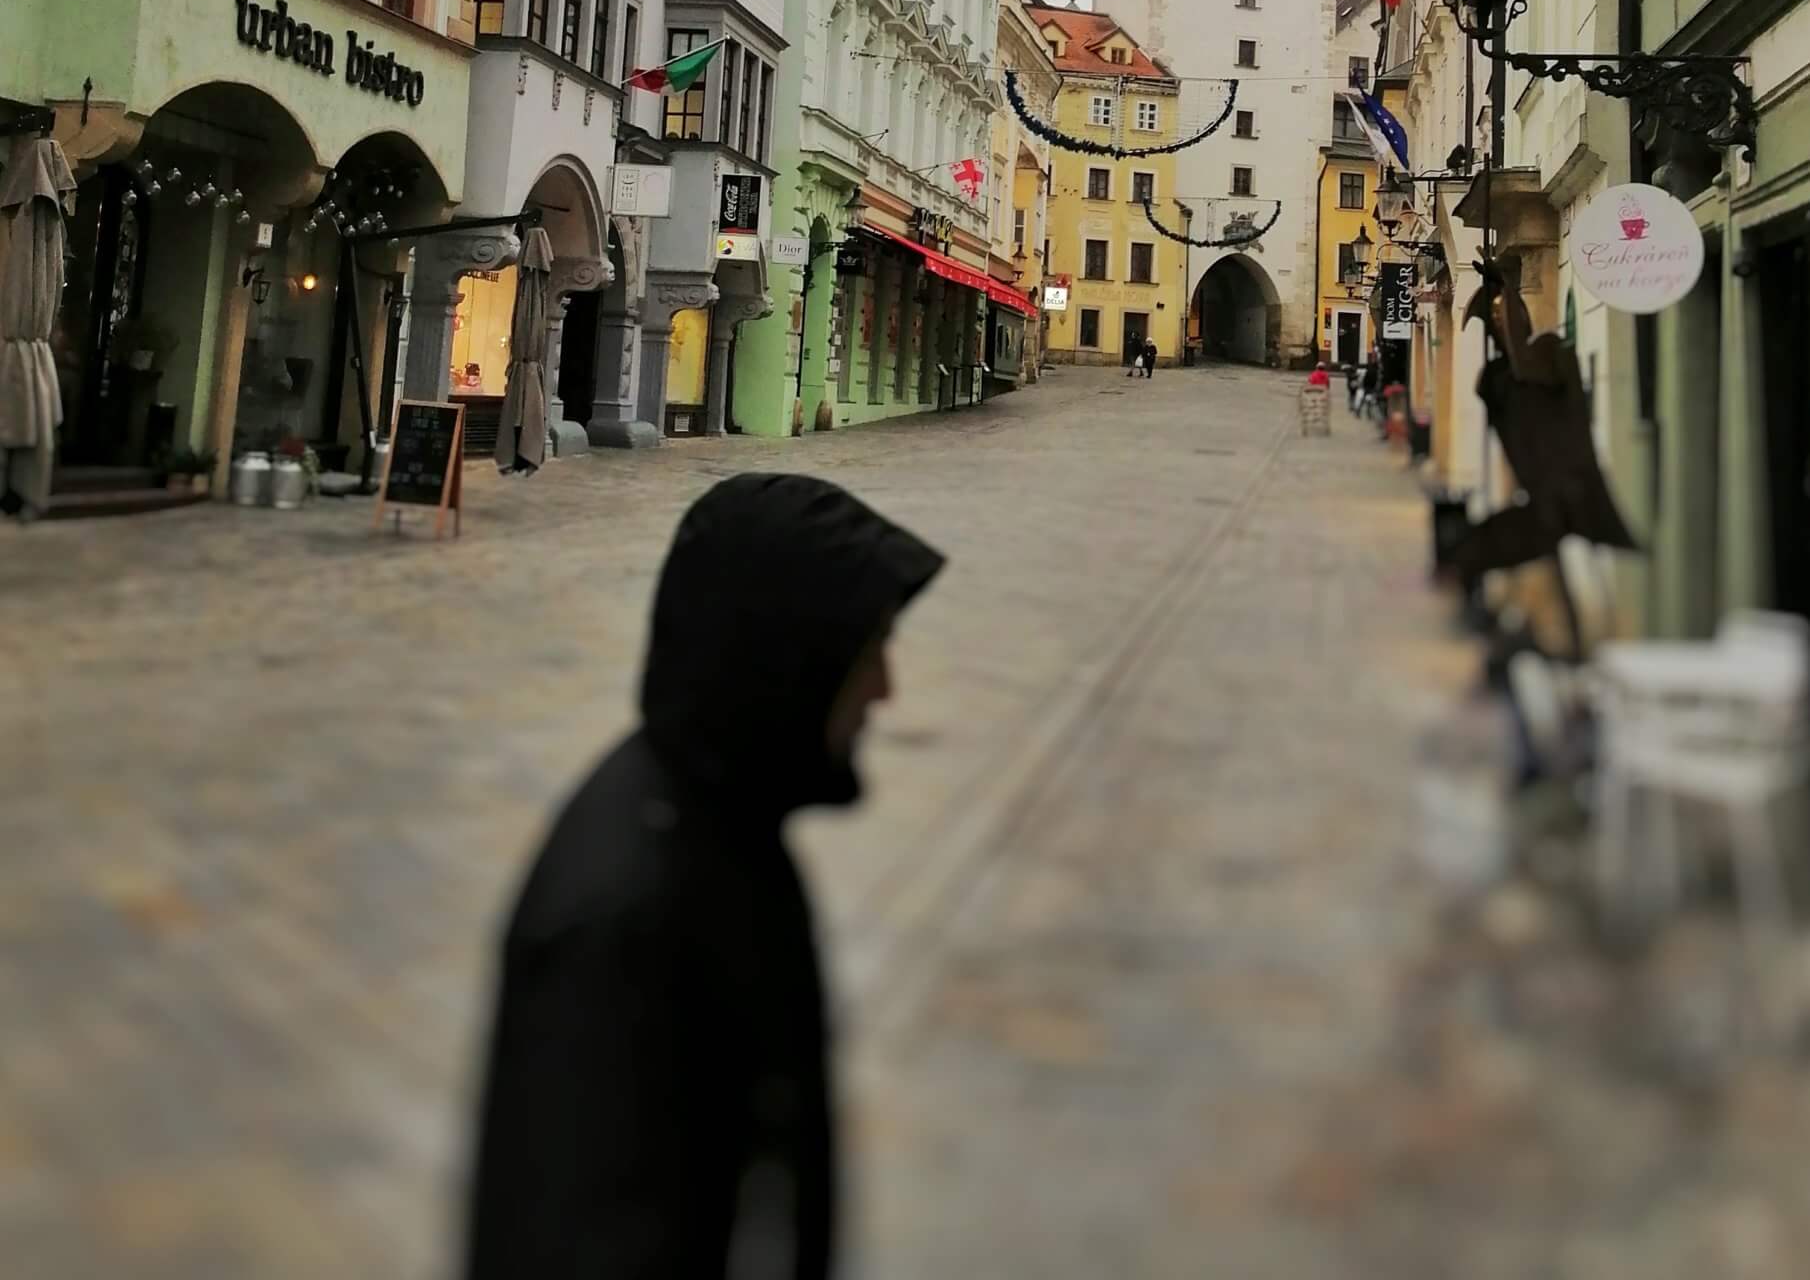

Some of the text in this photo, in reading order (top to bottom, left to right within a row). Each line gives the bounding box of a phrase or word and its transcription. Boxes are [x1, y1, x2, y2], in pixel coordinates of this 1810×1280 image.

[346, 30, 424, 106] bistro
[779, 243, 803, 254] Dior
[1386, 297, 1395, 321] DOM
[1396, 266, 1413, 321] CIGÁR
